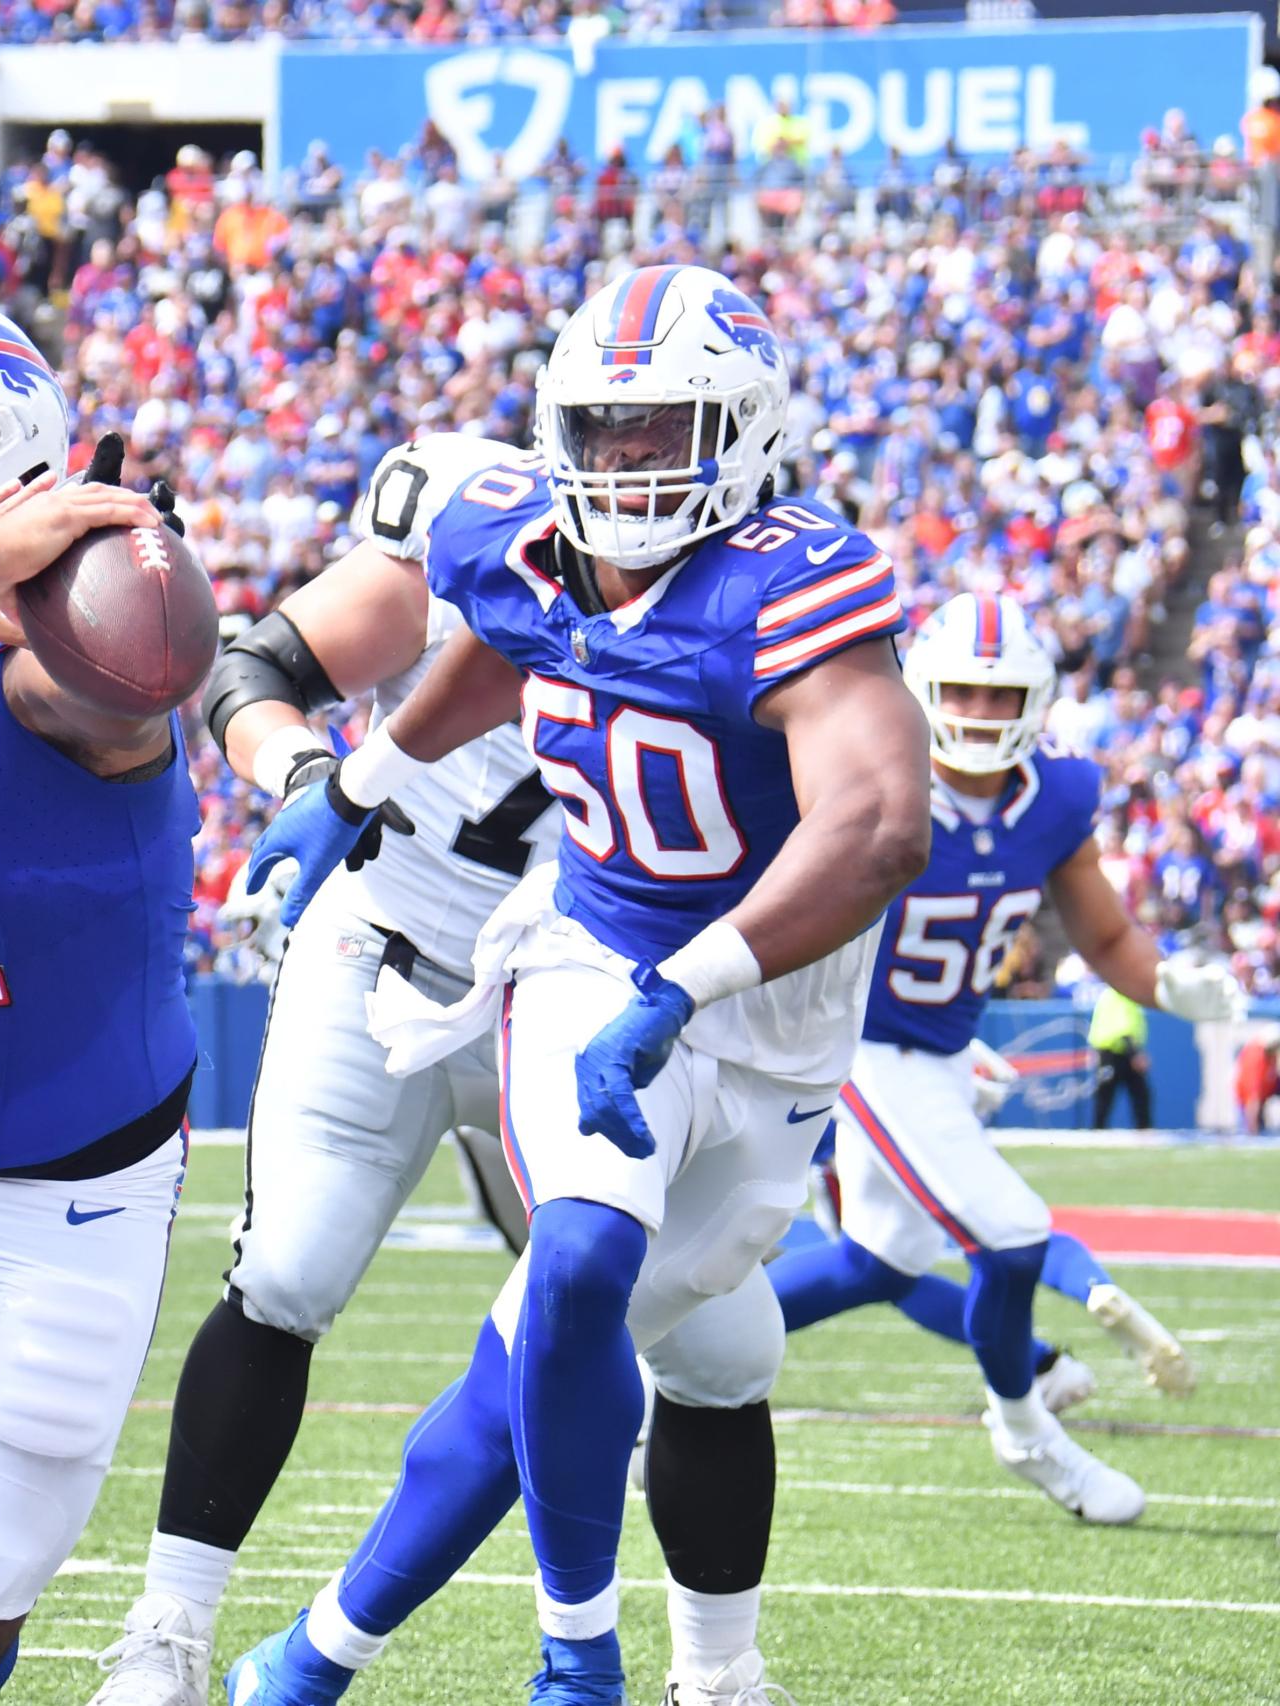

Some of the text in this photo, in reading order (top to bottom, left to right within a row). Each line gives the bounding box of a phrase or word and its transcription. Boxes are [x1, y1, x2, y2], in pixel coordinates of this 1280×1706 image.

[595, 65, 1090, 163] FANDUEL
[371, 459, 429, 541] 0
[724, 505, 840, 554] 50
[521, 667, 750, 882] 50
